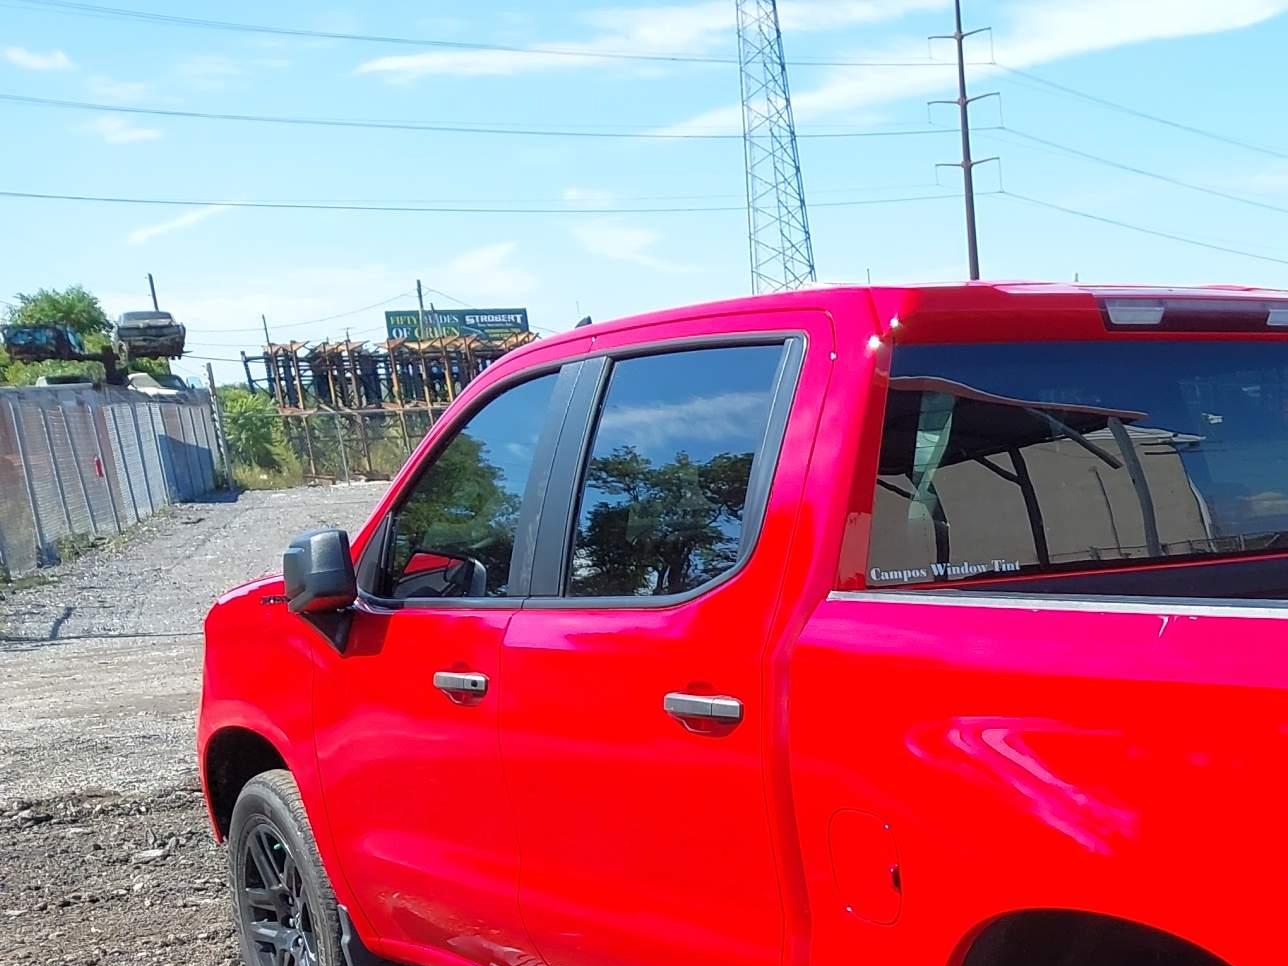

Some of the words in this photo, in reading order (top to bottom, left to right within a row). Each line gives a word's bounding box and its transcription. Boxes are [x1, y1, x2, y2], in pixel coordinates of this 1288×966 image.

[389, 315, 417, 325] FIFTY
[464, 314, 523, 326] STROBERT
[391, 327, 412, 340] OF
[870, 567, 927, 582] Campos
[930, 561, 989, 577] Window
[991, 559, 1021, 572] Tint
